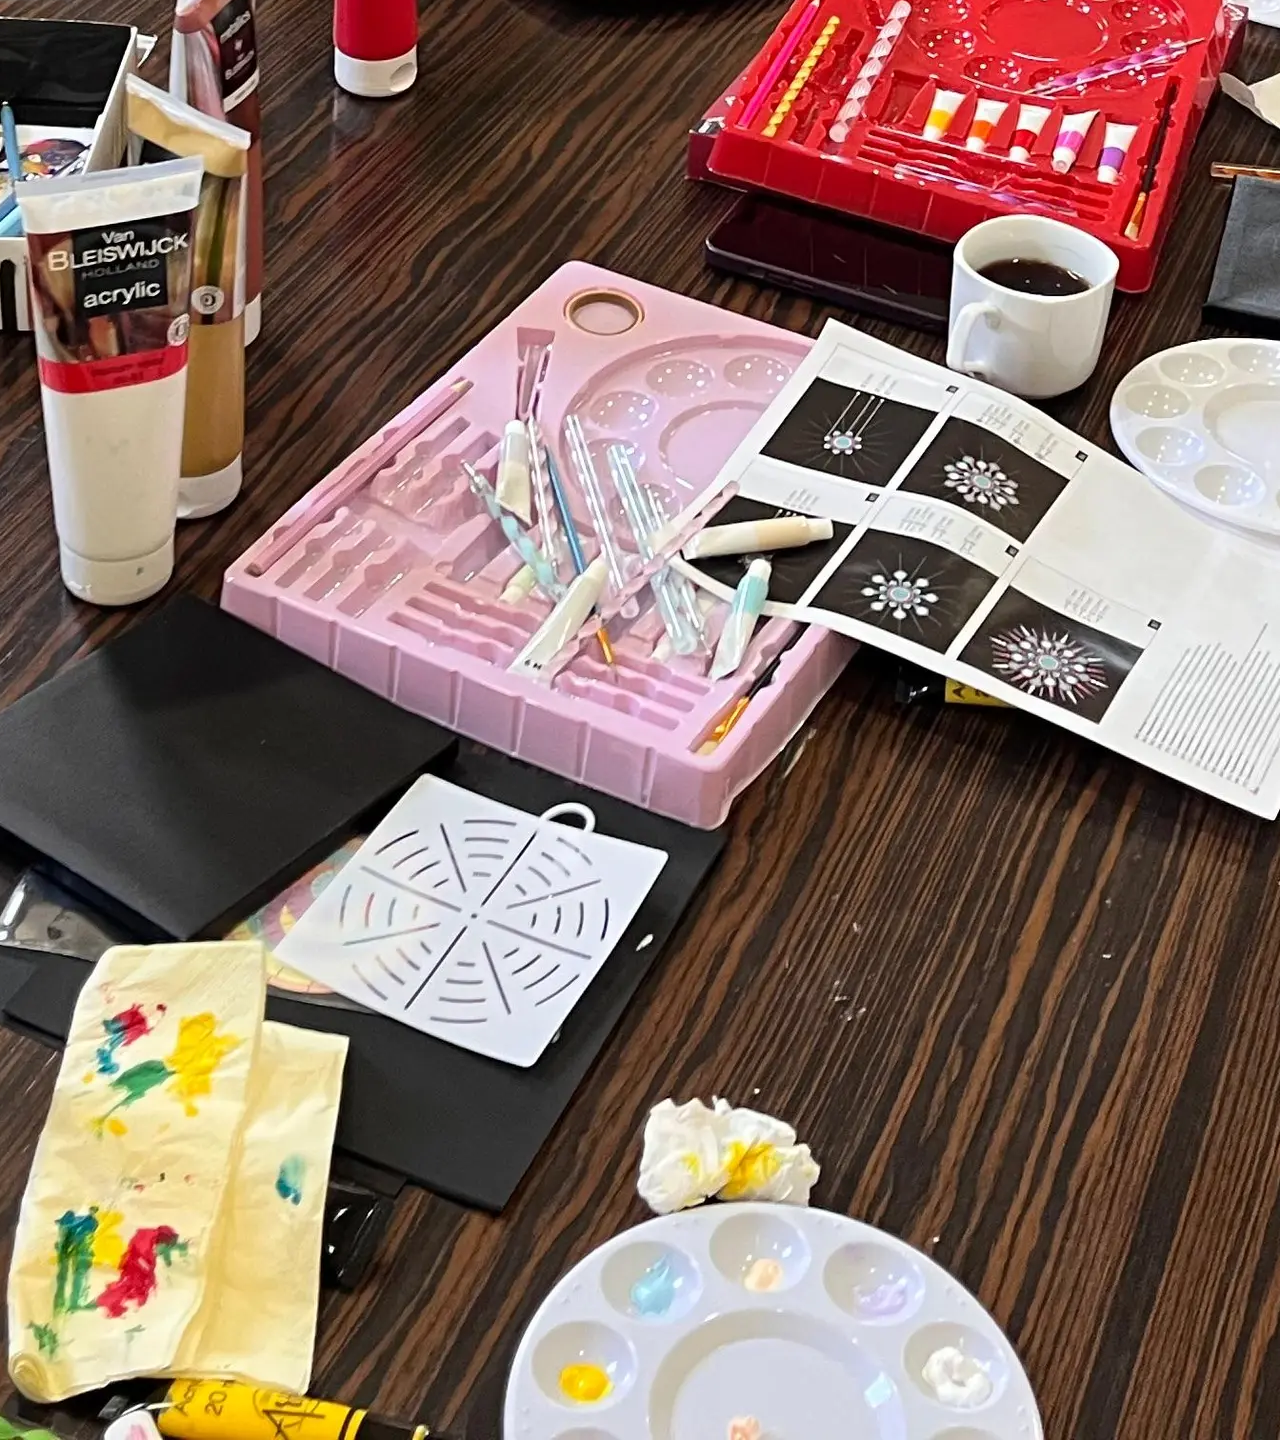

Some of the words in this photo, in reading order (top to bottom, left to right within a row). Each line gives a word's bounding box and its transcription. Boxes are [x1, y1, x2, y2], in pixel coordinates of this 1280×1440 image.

[101, 229, 135, 245] Van
[47, 233, 189, 273] BLEISWIJCK
[81, 257, 160, 281] HOLLAND
[83, 279, 161, 309] acrylic
